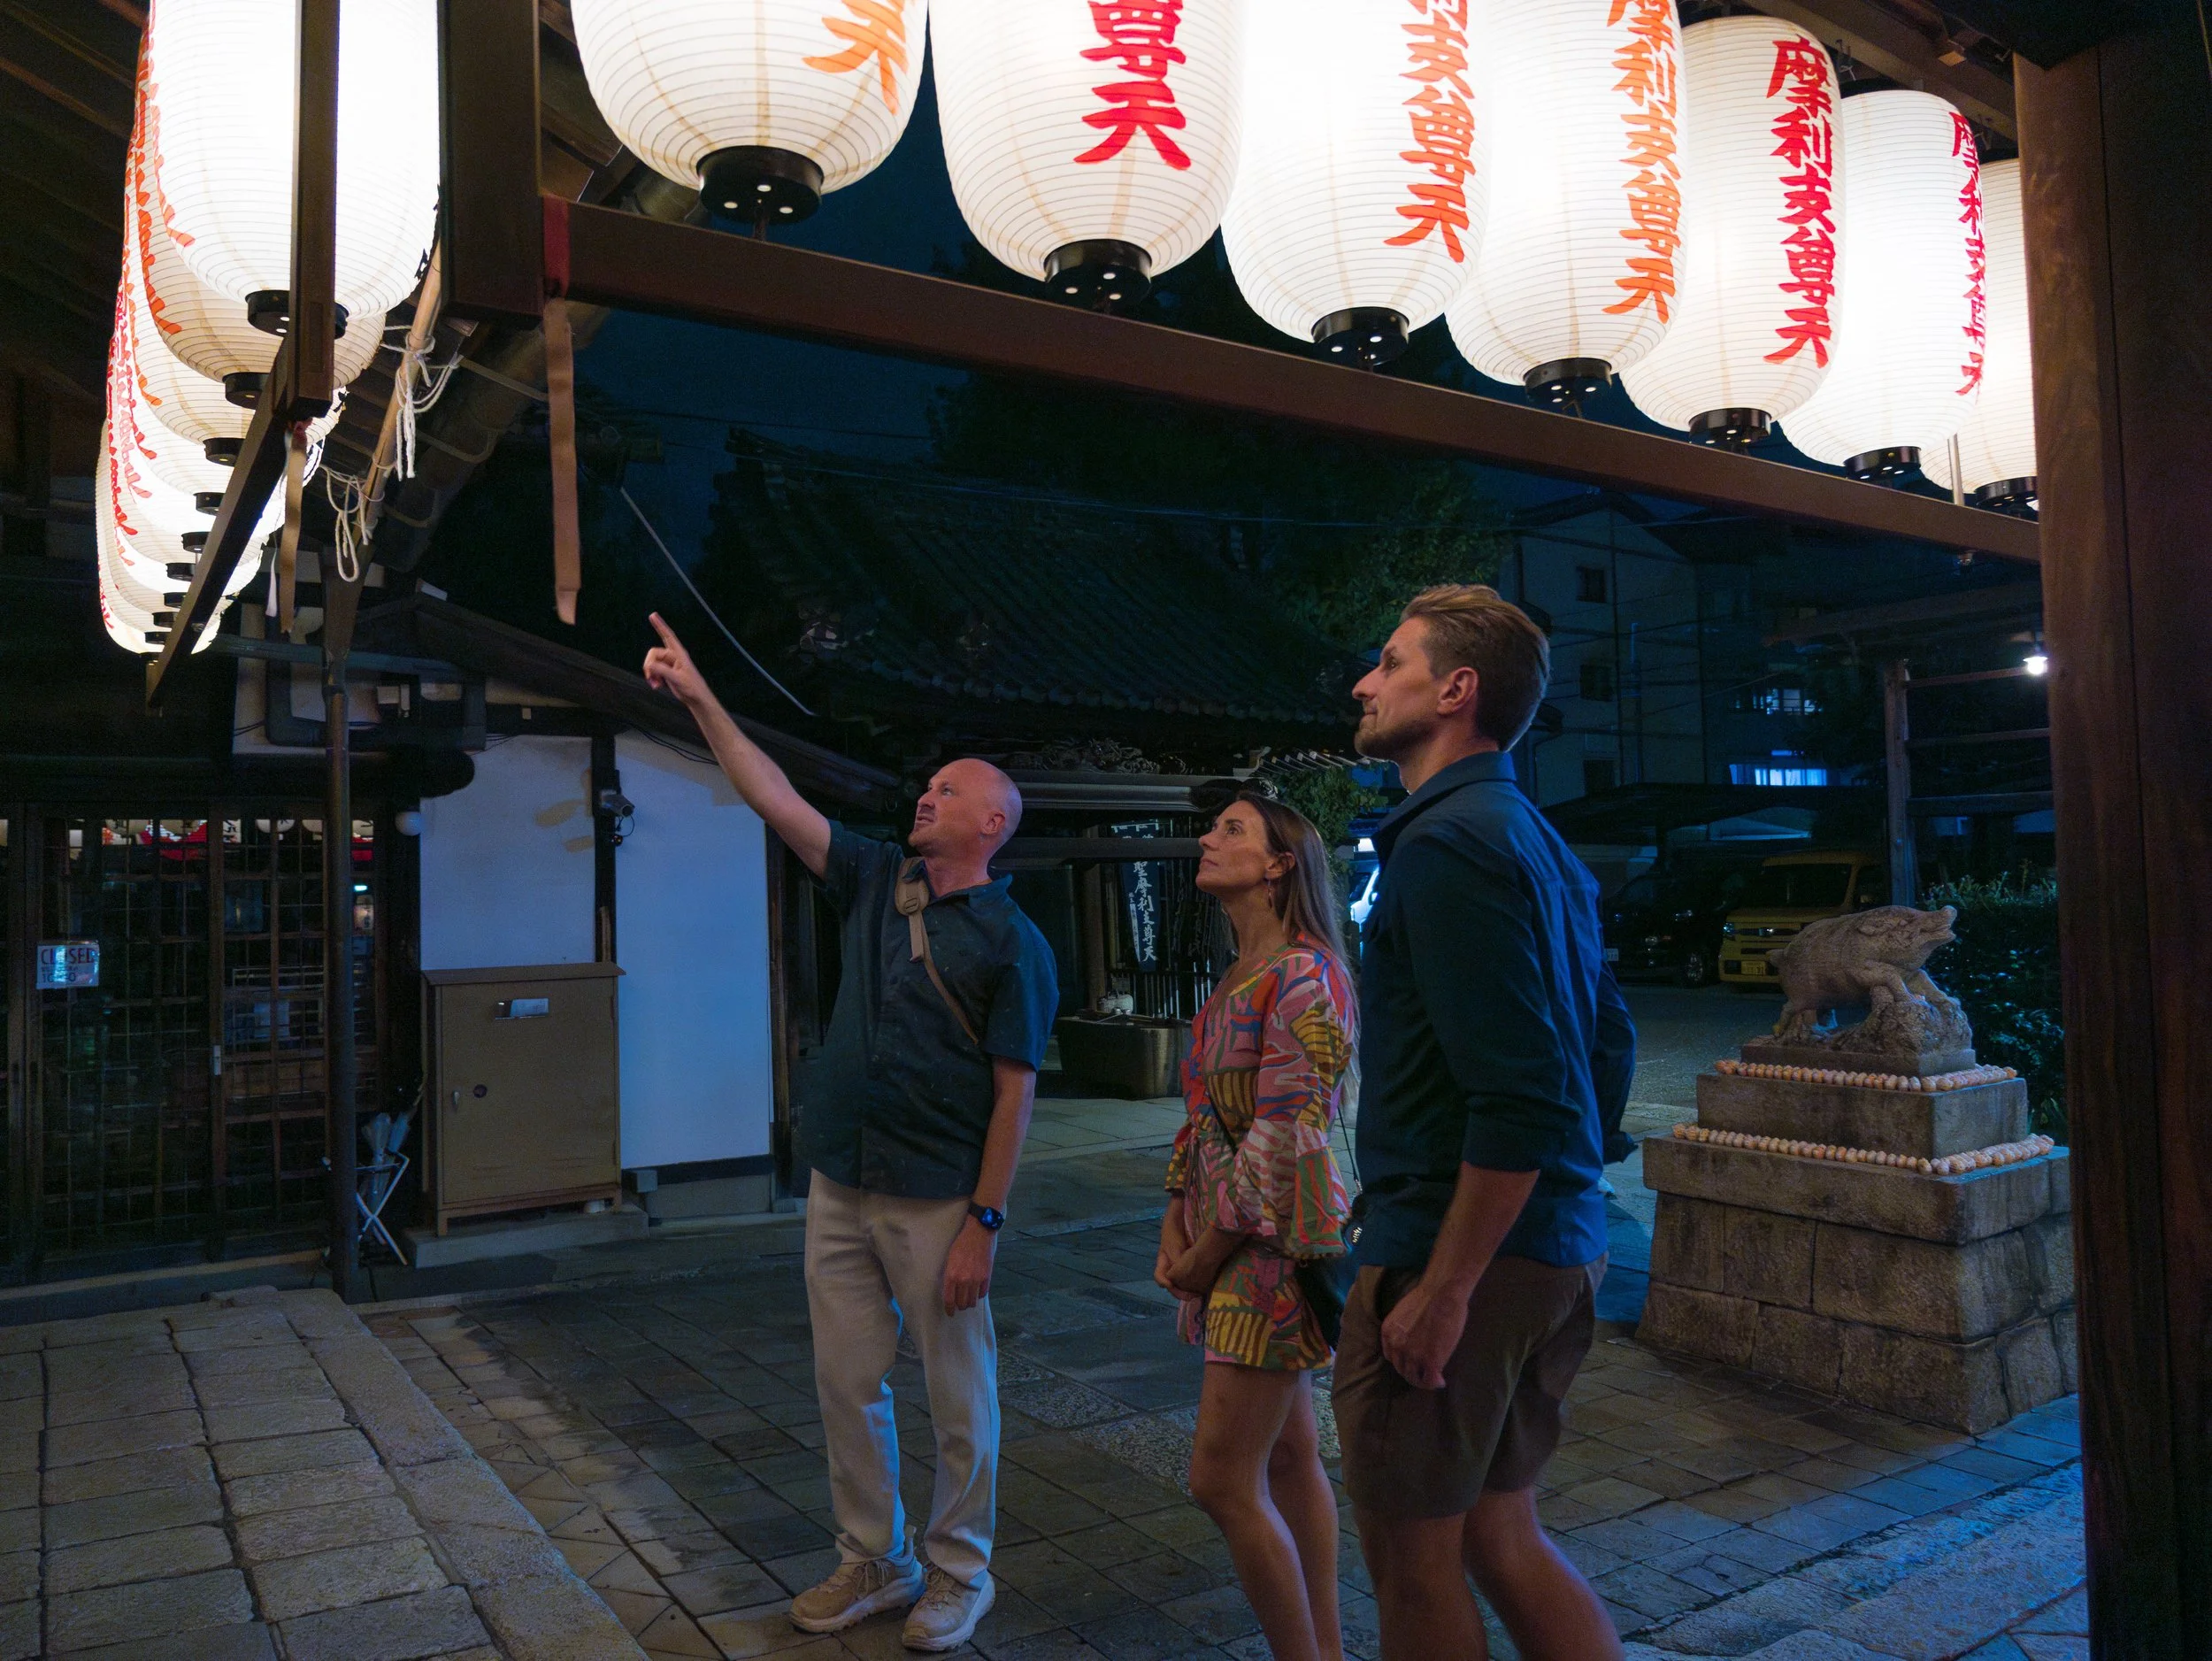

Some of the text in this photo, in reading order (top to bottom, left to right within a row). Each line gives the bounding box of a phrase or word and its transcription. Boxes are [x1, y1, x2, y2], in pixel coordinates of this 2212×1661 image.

[1763, 36, 1838, 369] 摩利支尊天
[40, 948, 96, 965] CLSED
